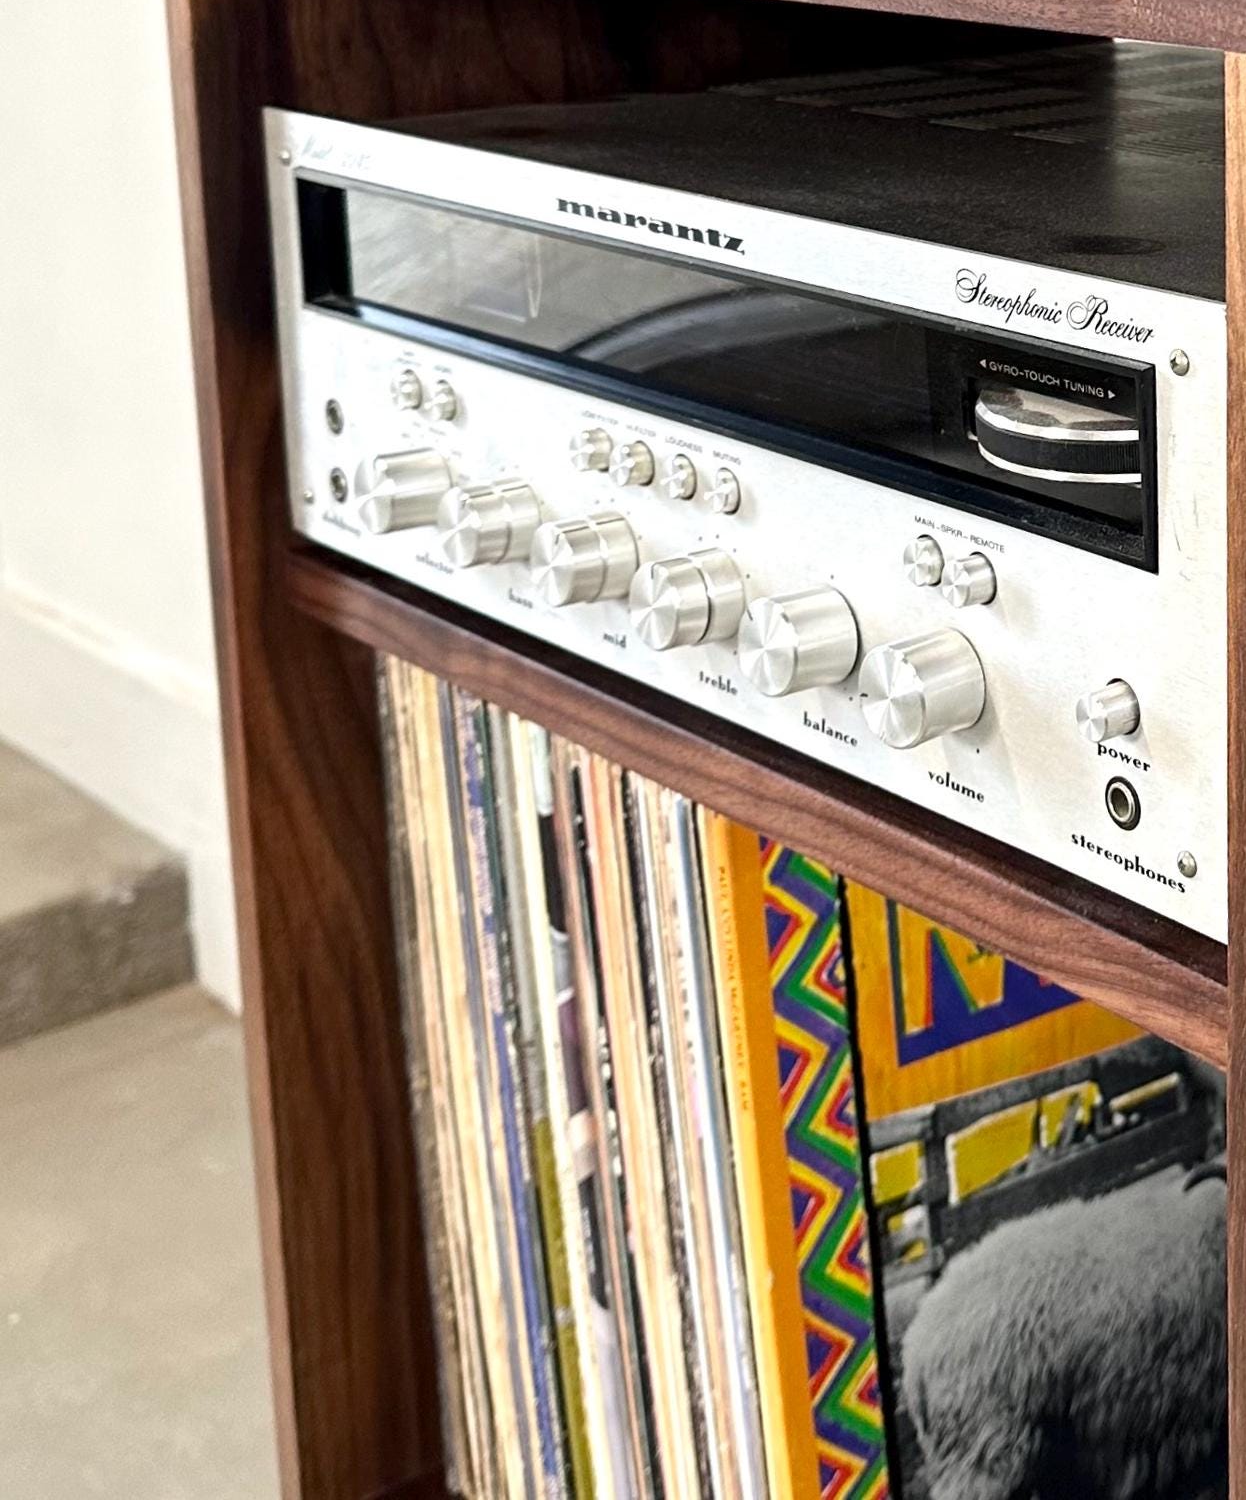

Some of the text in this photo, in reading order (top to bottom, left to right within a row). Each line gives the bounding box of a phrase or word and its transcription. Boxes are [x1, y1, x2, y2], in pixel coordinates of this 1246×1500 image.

[556, 197, 745, 256] marantz
[955, 268, 1155, 343] Stereophonic Receiver
[989, 361, 1104, 398] GYRO-TOUCH TUNING
[914, 515, 935, 529] MAIN
[969, 534, 1006, 553] REMOTE
[509, 588, 534, 609] bass
[603, 630, 626, 649] mid
[700, 670, 738, 696] treble
[803, 711, 858, 747] balance
[1098, 742, 1151, 772] power
[928, 770, 985, 802] volume
[1072, 831, 1186, 893] stereophones
